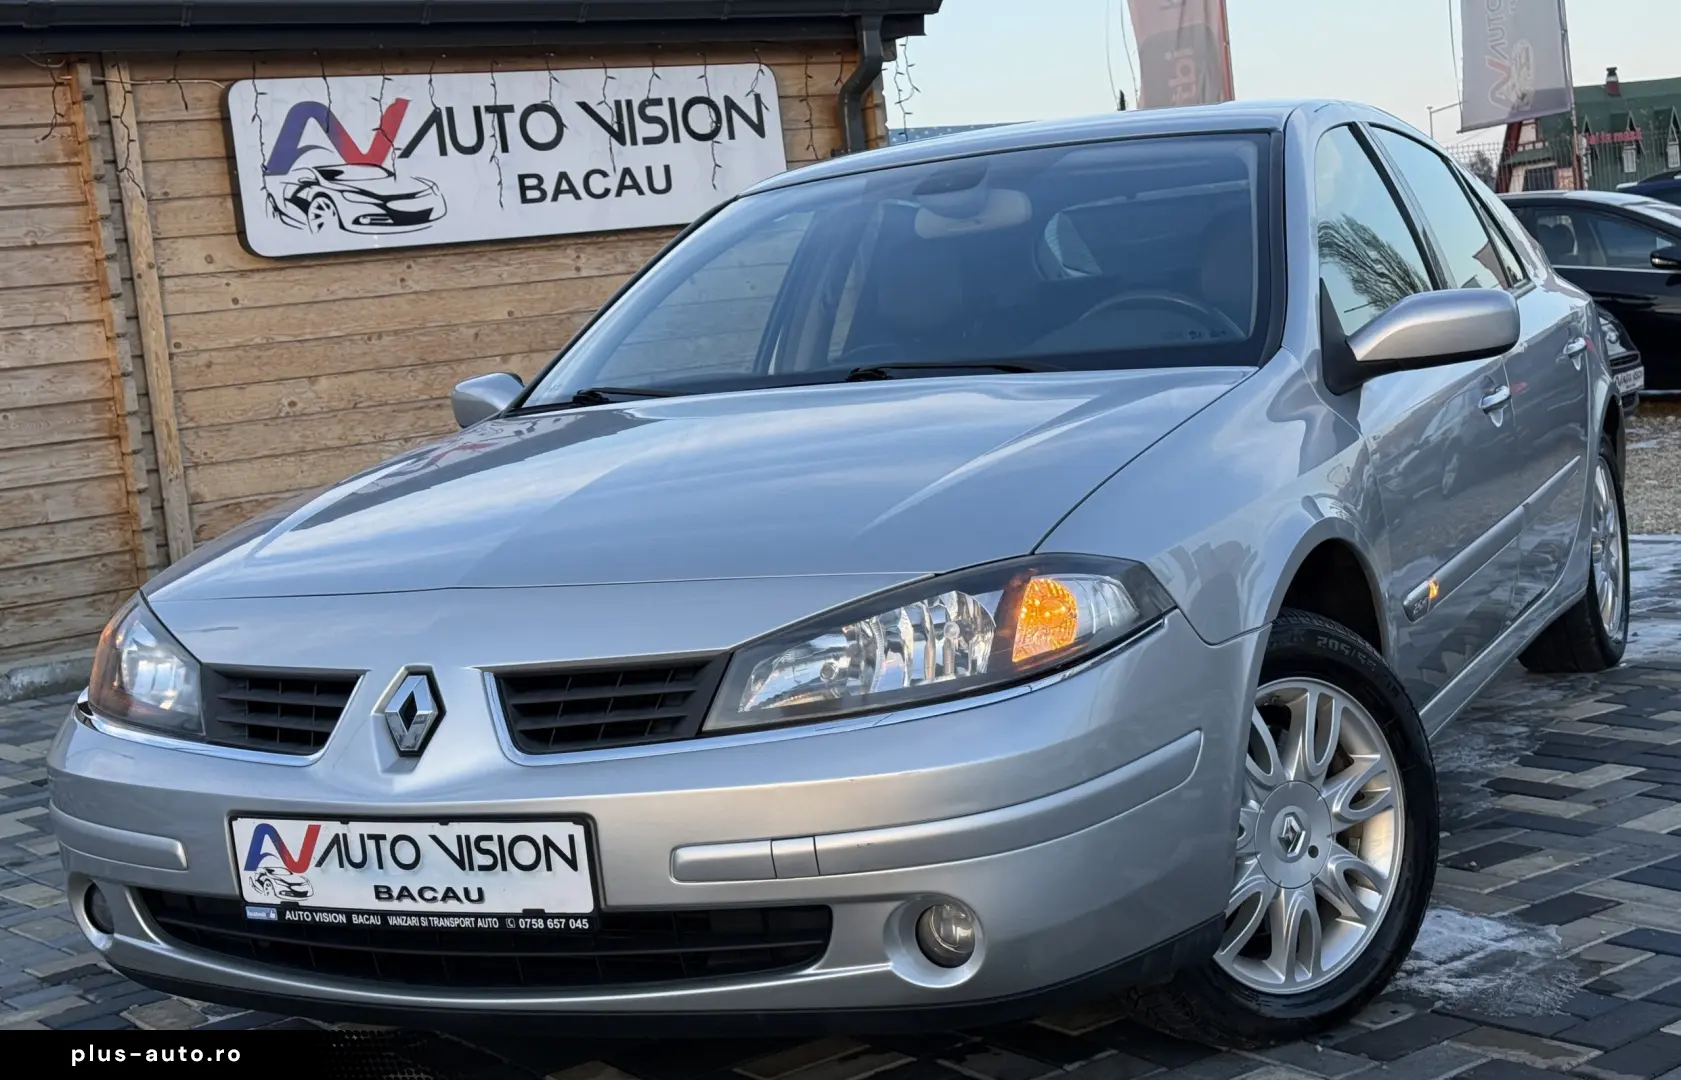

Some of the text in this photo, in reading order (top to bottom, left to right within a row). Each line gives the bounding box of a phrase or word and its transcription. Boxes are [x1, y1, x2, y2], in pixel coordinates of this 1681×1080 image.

[397, 93, 767, 159] AUTO VISION
[517, 164, 674, 205] BACAU
[314, 833, 579, 872] AUTO VISION
[373, 884, 485, 904] BACAU
[285, 910, 589, 929] AUTO VISION BACAU VANZARI SI TRANSPORT AUTO 0758 657 045
